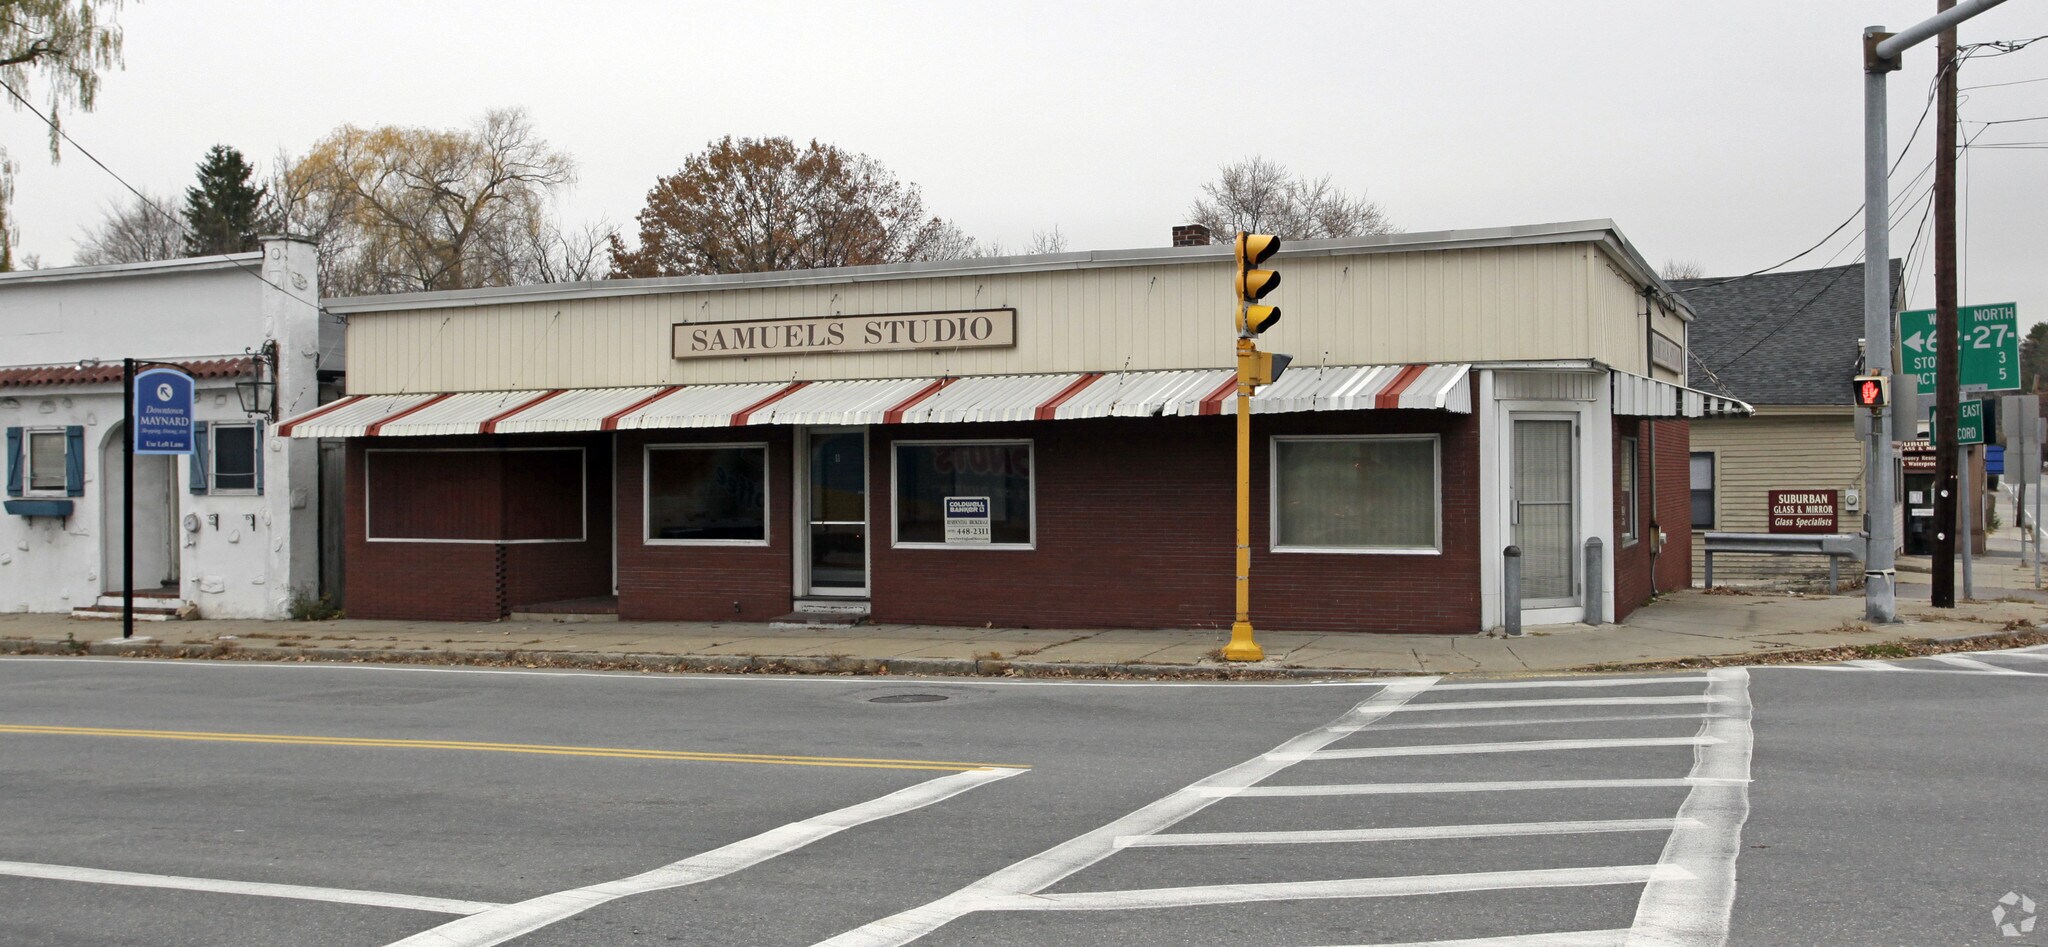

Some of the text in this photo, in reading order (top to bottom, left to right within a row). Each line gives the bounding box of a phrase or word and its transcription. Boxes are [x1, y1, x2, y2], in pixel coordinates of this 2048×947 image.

[1973, 307, 2014, 322] NORTH
[691, 316, 993, 352] SAMUELS STUDIO
[1913, 351, 2006, 369] STO 3
[1916, 368, 2007, 385] ACT 5
[146, 405, 184, 414] Downtown
[1962, 404, 1980, 418] EAST
[140, 416, 189, 426] MAYNARD
[1957, 427, 1976, 440] CORD
[1778, 494, 1828, 504] SUBURBAN
[1773, 505, 1833, 514] GLASS & MIRROR
[1774, 517, 1833, 528] Glass Specialists
